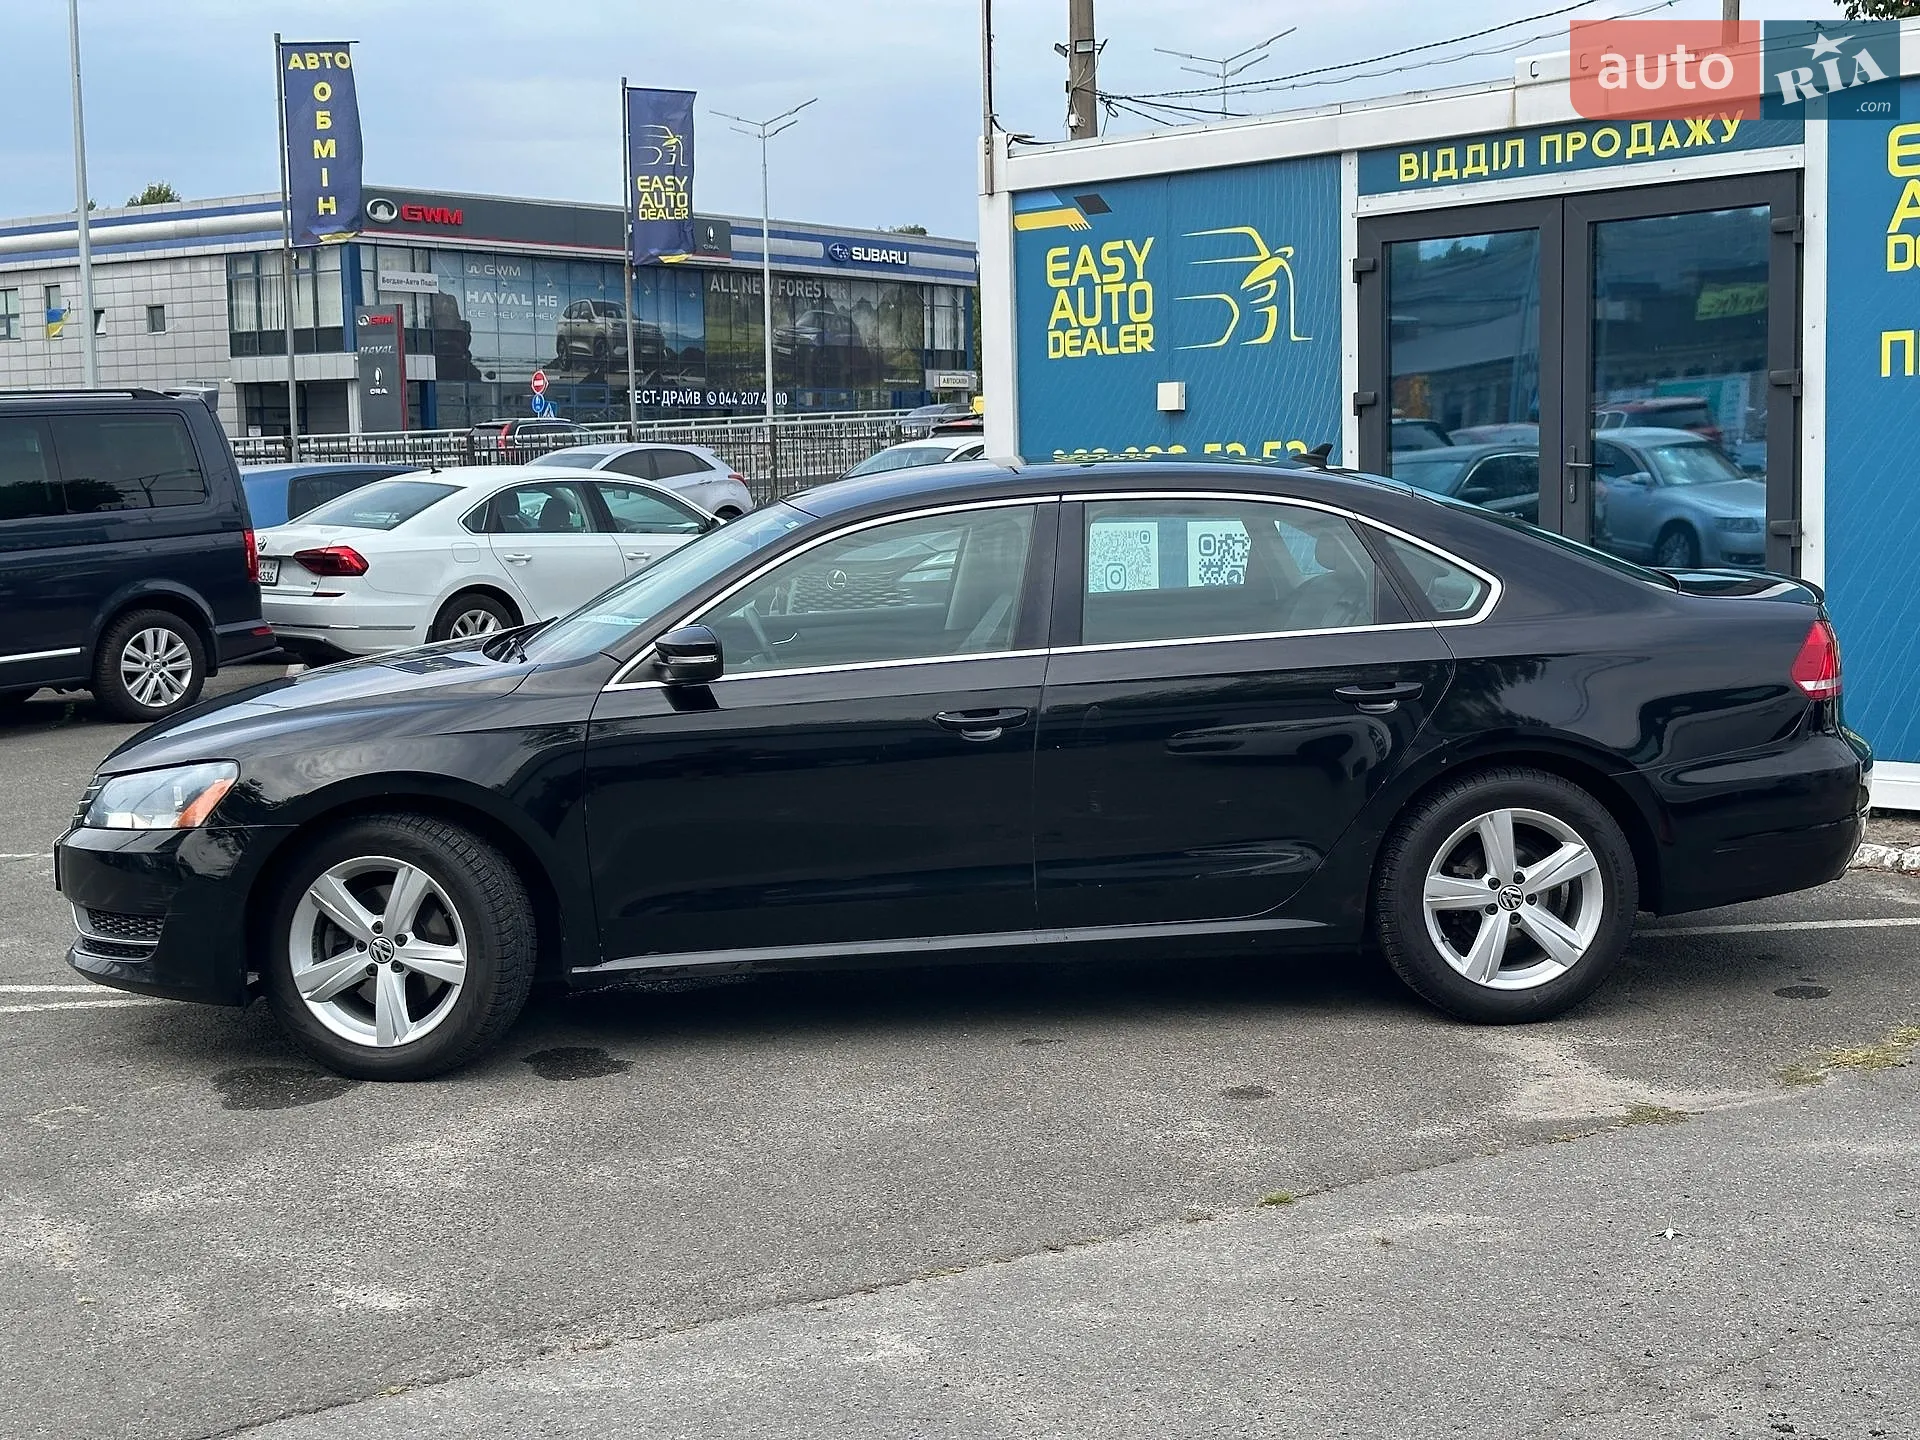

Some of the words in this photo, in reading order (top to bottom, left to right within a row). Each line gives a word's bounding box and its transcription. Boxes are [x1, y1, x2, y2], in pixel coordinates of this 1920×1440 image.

[288, 52, 350, 70] АВТО
[313, 81, 337, 216] ОБМІН
[1399, 138, 1525, 183] ВІДДІЛ
[1540, 109, 1745, 166] ПРОДАЖУ
[637, 175, 688, 192] EASY
[639, 192, 688, 209] AUTO
[402, 203, 464, 225] GWM
[639, 208, 688, 221] DEALER
[851, 247, 907, 265] SUBARU
[1046, 236, 1155, 288] EASY
[484, 264, 521, 276] GWM
[710, 273, 738, 293] ALL
[466, 290, 532, 306] HAVAL
[537, 295, 558, 307] H6
[1048, 281, 1154, 330] AUTO
[360, 345, 395, 355] HAVAL
[1048, 323, 1155, 360] DEALER
[719, 391, 738, 406] 044
